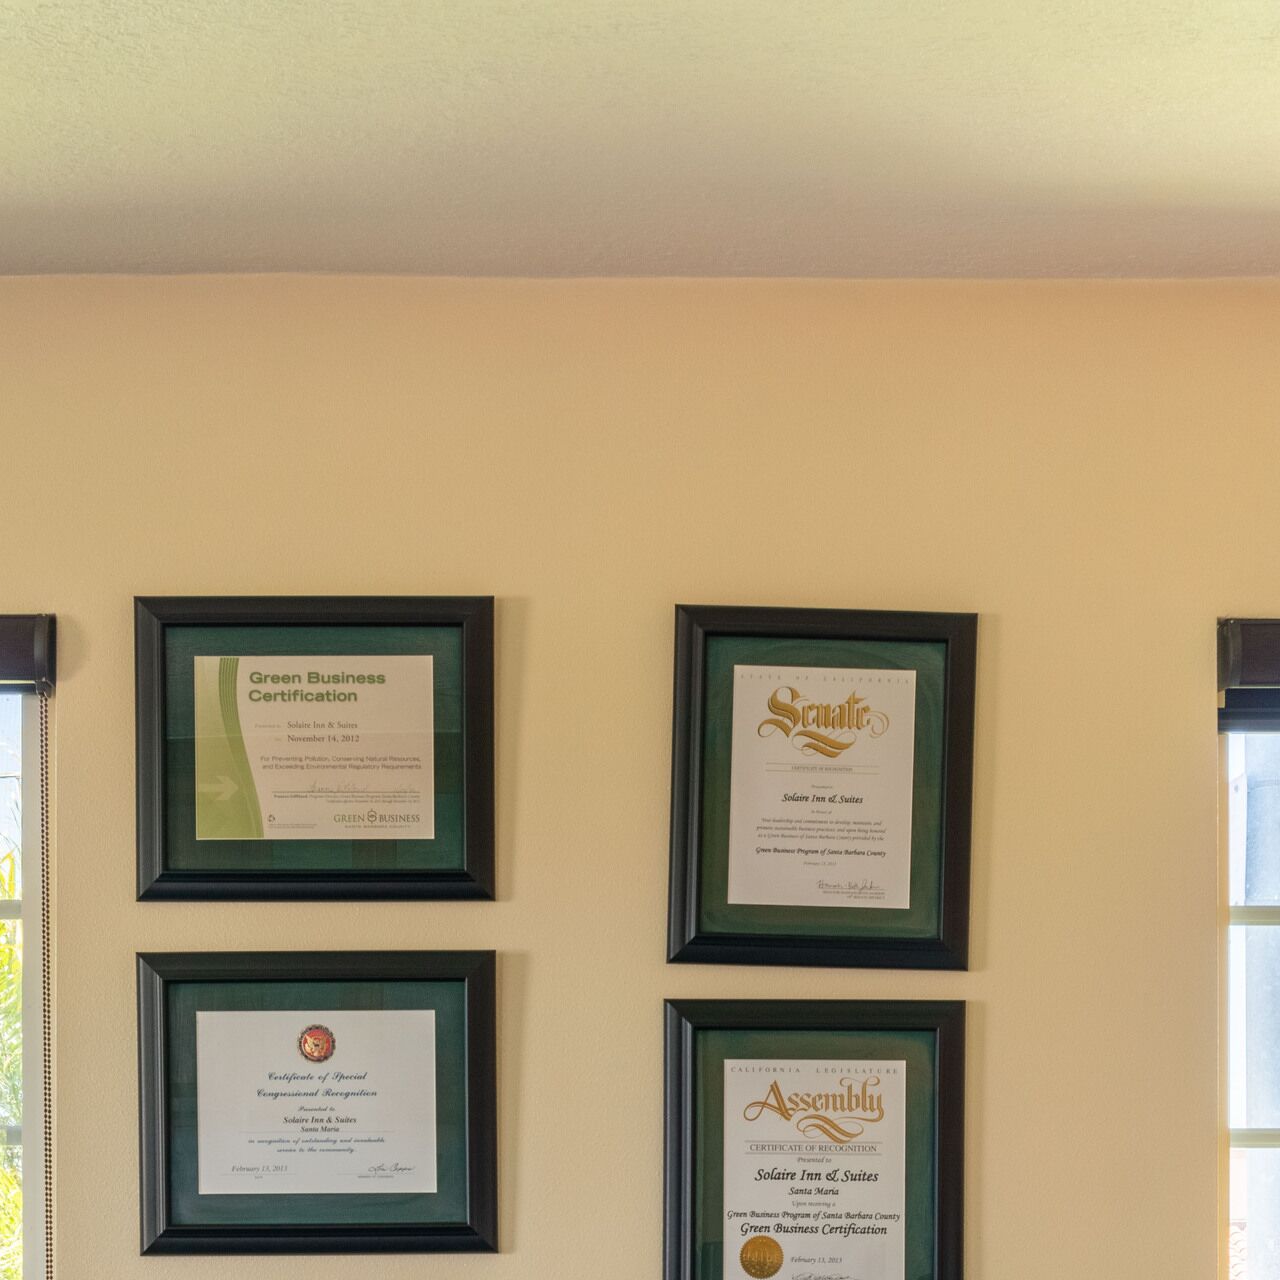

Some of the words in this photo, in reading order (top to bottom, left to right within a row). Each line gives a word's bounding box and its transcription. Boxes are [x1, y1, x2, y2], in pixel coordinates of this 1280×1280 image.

[250, 672, 301, 684] Green
[308, 672, 386, 684] Business
[249, 690, 357, 702] Certification
[758, 686, 889, 746] Senate
[782, 793, 810, 802] Solaire
[812, 794, 826, 802] Inn
[828, 794, 838, 804] &
[839, 794, 864, 804] Suites
[334, 814, 364, 822] GREEN
[380, 814, 420, 822] BUSINESS
[268, 1072, 314, 1084] Certificate
[318, 1072, 328, 1084] of
[332, 1072, 368, 1084] Special
[256, 1088, 319, 1100] Congressional
[322, 1088, 377, 1100] Recognition
[744, 1076, 884, 1130] Assembly
[283, 1116, 308, 1124] Solaire
[750, 1144, 804, 1152] CERTIFICATE
[818, 1144, 878, 1152] RECOGNITION
[754, 1168, 796, 1182] Solaire
[800, 1170, 822, 1181] Inn
[826, 1169, 840, 1182] &
[841, 1170, 879, 1182] Suites
[789, 1187, 812, 1196] Santa
[814, 1188, 839, 1196] Maria
[727, 1210, 748, 1220] Green
[782, 1212, 810, 1220] Program
[812, 1212, 821, 1220] of
[822, 1212, 842, 1220] Santa
[845, 1212, 872, 1220] Barbara
[874, 1212, 900, 1222] County
[740, 1223, 770, 1236] Green
[774, 1223, 818, 1234] Business
[822, 1223, 888, 1238] Certification
